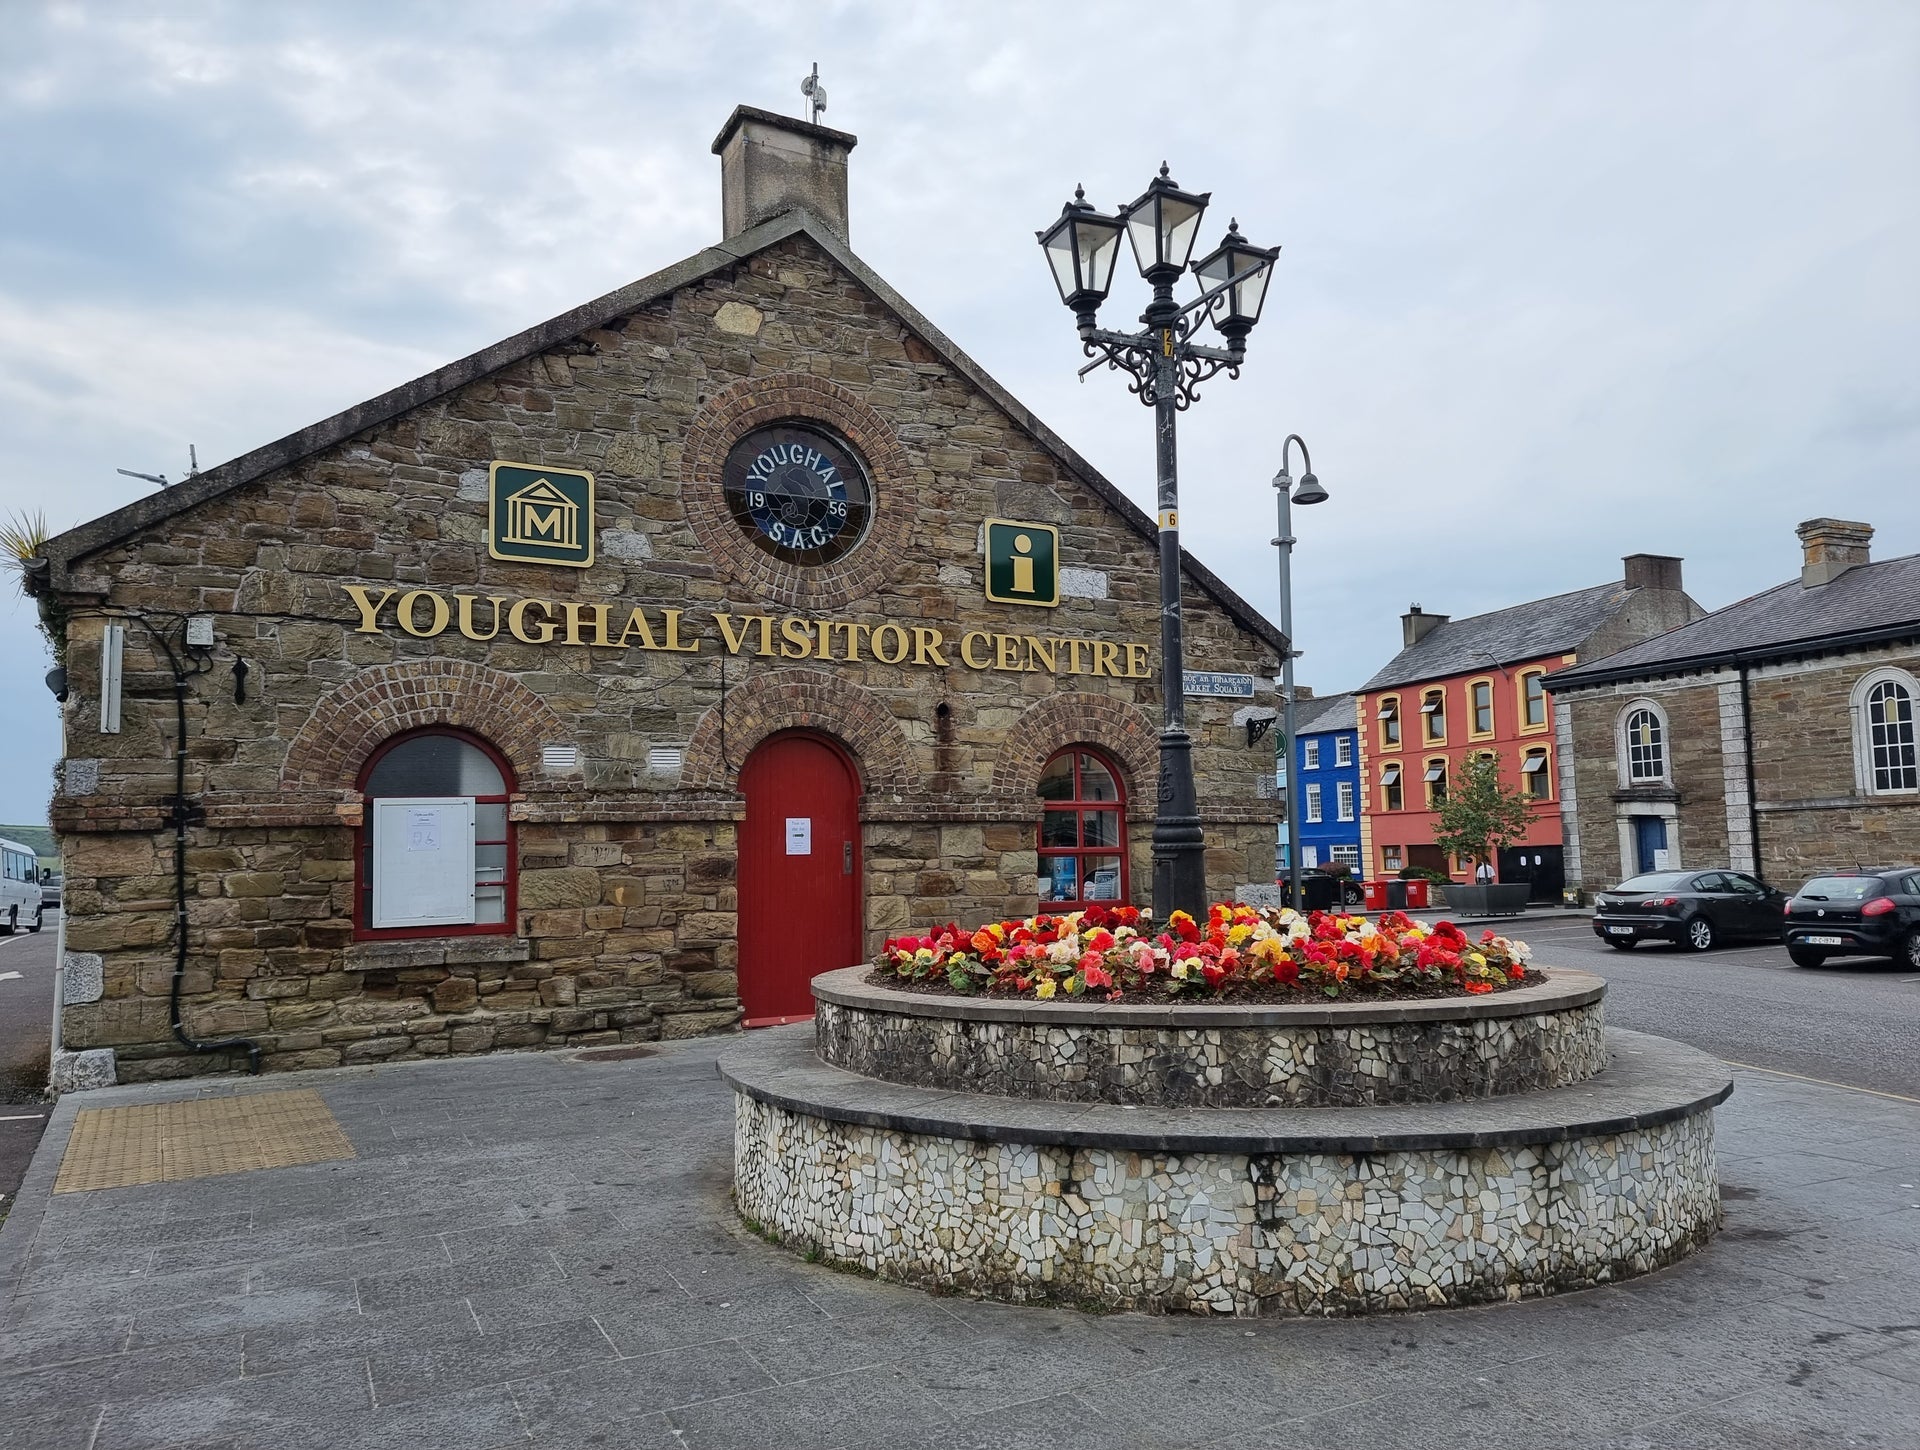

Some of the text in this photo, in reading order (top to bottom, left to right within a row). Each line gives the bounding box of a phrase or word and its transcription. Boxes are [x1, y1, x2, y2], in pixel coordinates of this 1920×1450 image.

[746, 444, 844, 497] YOUGHAL
[524, 504, 561, 540] M
[750, 492, 847, 517] 19 56
[1169, 513, 1176, 526] 6
[769, 522, 834, 549] S.A.C.
[1010, 534, 1035, 593] i
[341, 585, 1152, 679] YOUGHAL VISITOR CENTRE
